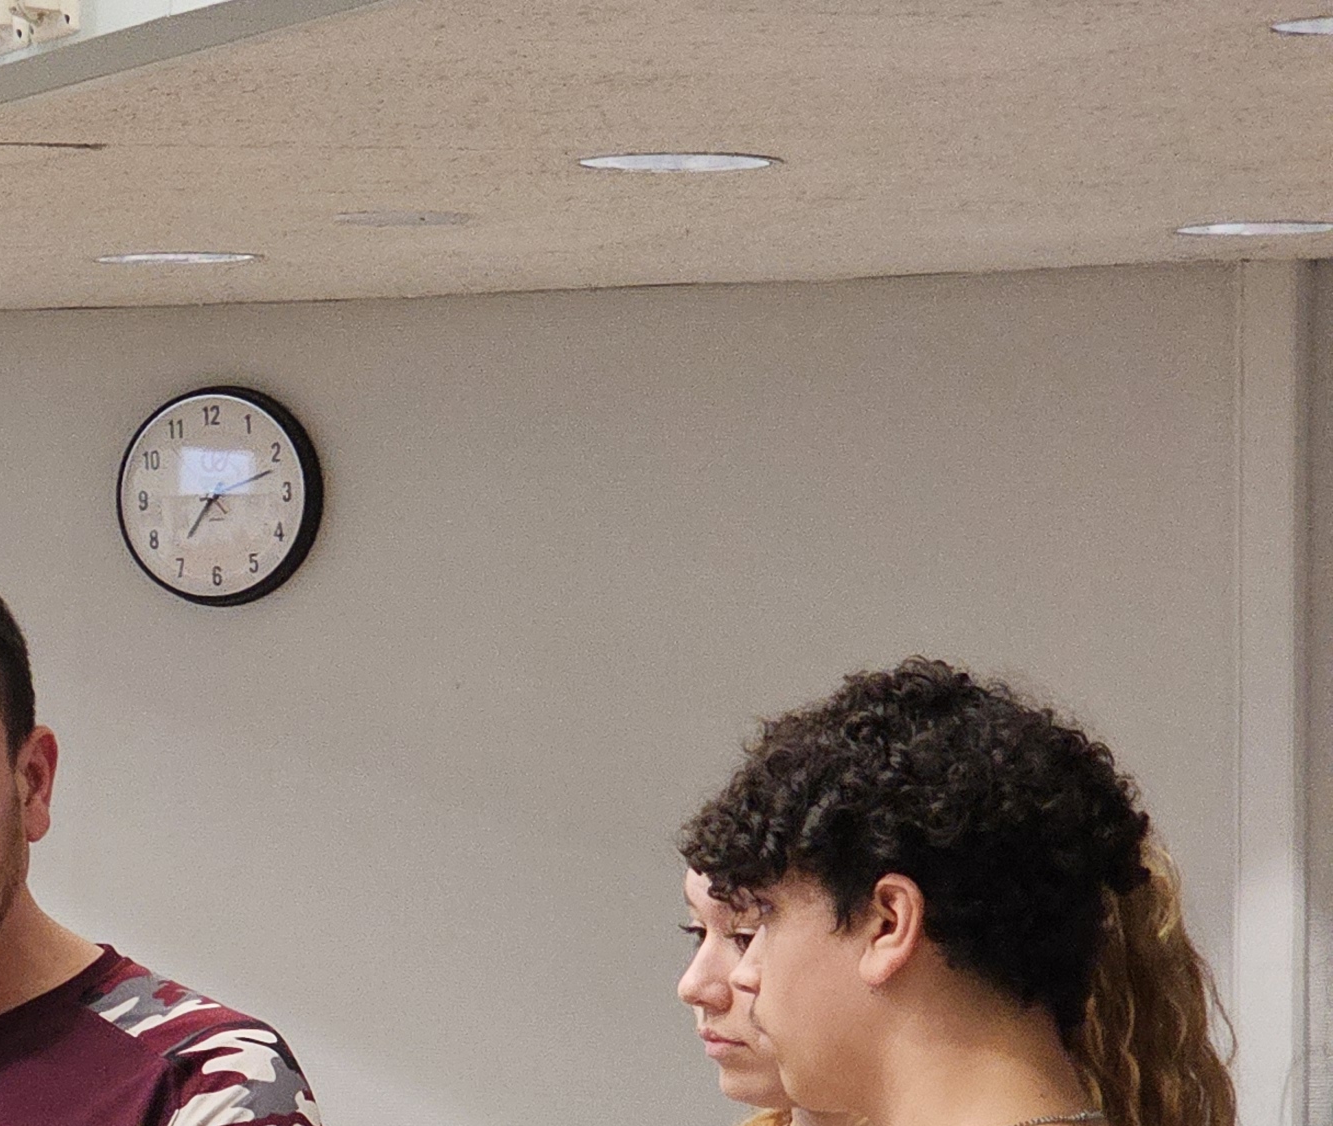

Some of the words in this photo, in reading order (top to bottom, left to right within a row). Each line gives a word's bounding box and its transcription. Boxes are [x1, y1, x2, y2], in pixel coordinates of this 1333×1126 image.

[202, 405, 221, 426] 12
[245, 414, 252, 434] 1
[168, 419, 184, 439] 11
[142, 451, 160, 470] 10
[271, 442, 281, 463] 2
[138, 491, 149, 511] 9
[282, 481, 292, 502] 3
[149, 530, 159, 550] 8
[273, 522, 284, 541] 4
[175, 558, 185, 578] 7
[249, 553, 259, 573] 5
[212, 566, 222, 586] 6
